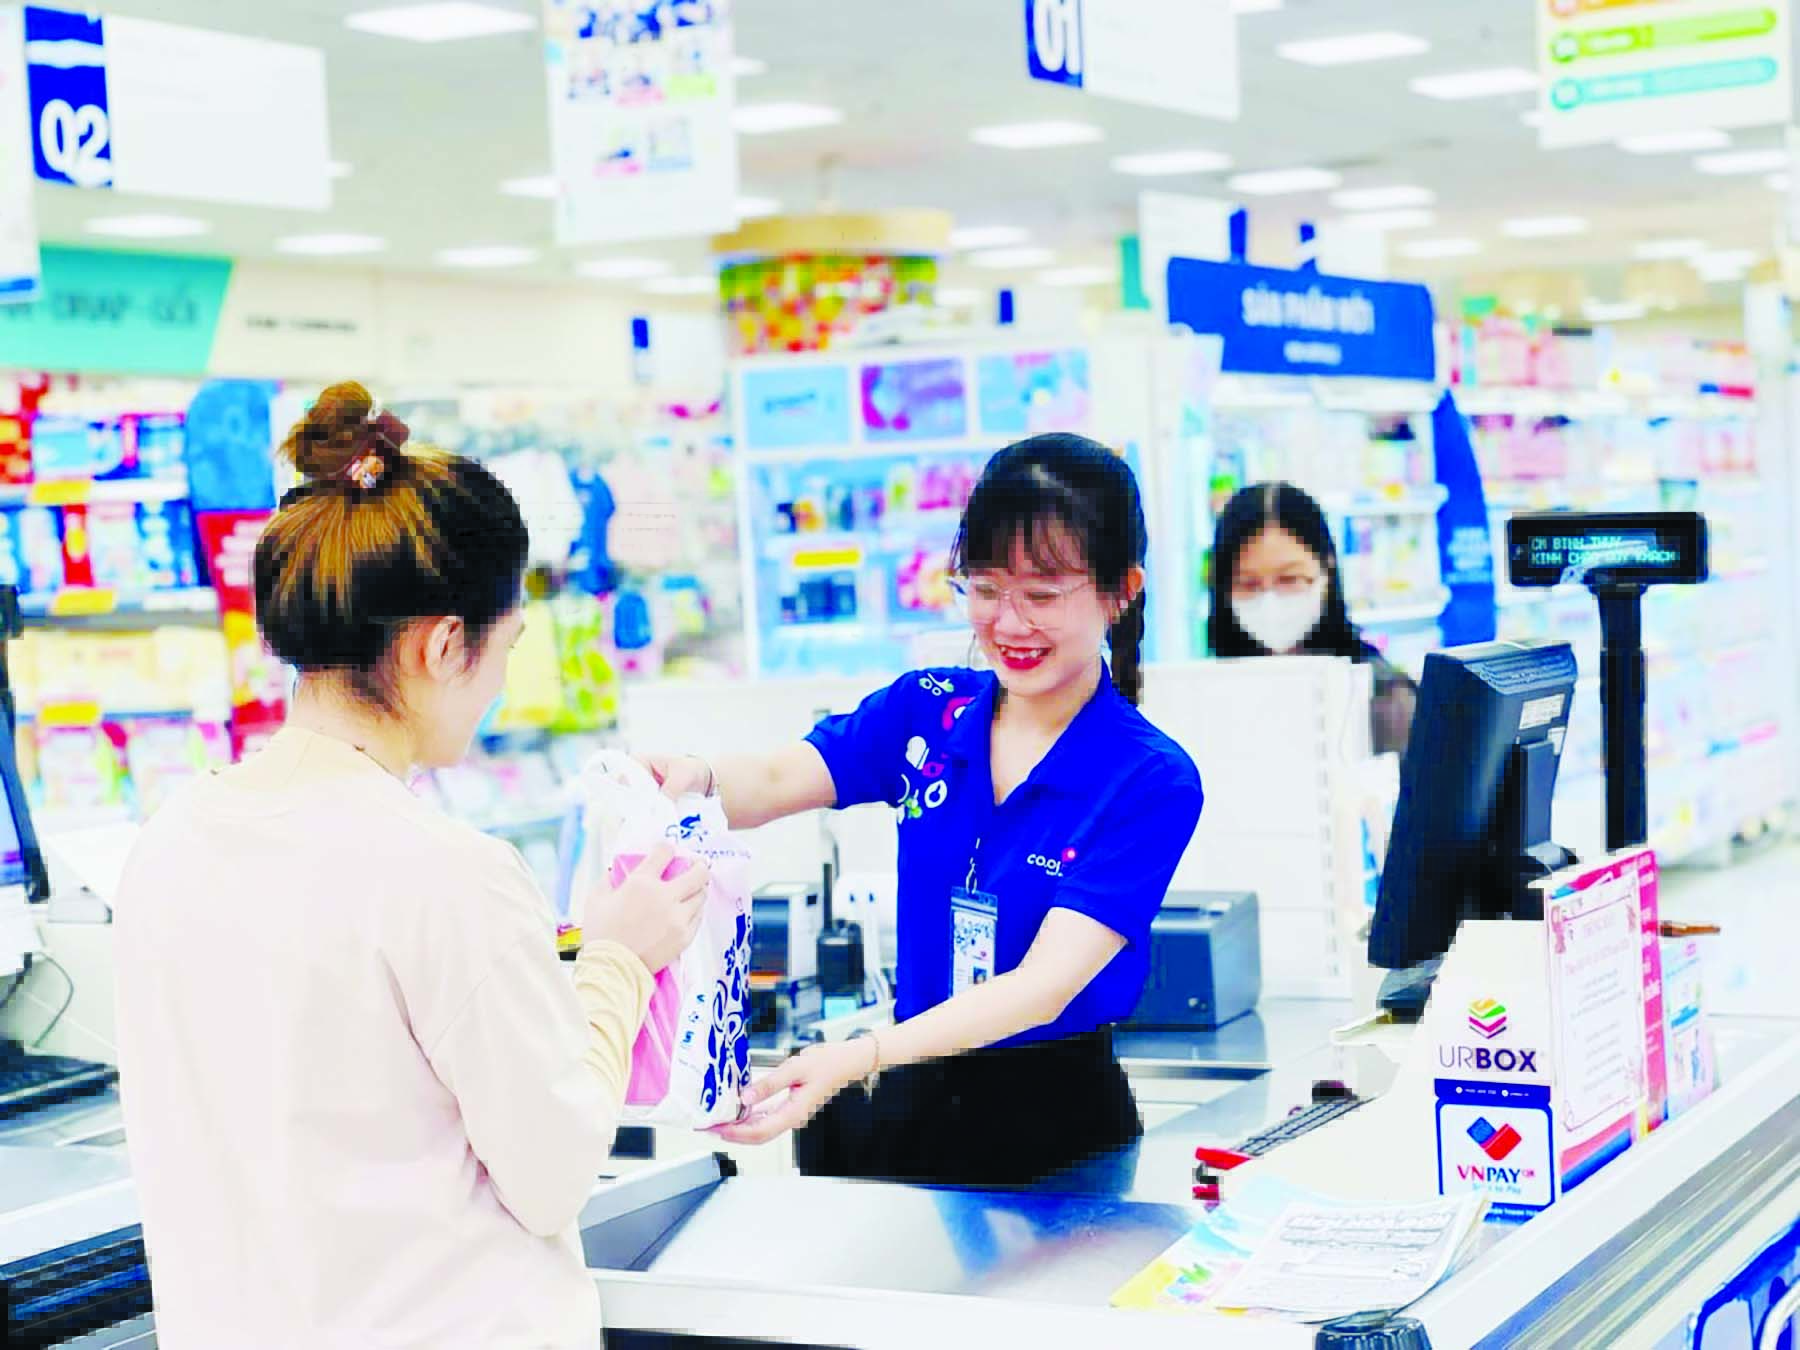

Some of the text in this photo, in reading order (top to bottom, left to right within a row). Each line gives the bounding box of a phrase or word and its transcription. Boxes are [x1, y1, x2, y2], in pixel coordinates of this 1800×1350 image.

[1033, 0, 1081, 75] 01
[40, 98, 111, 187] 02
[1439, 1044, 1537, 1073] URBOX
[1456, 1164, 1521, 1184] VNPAY
